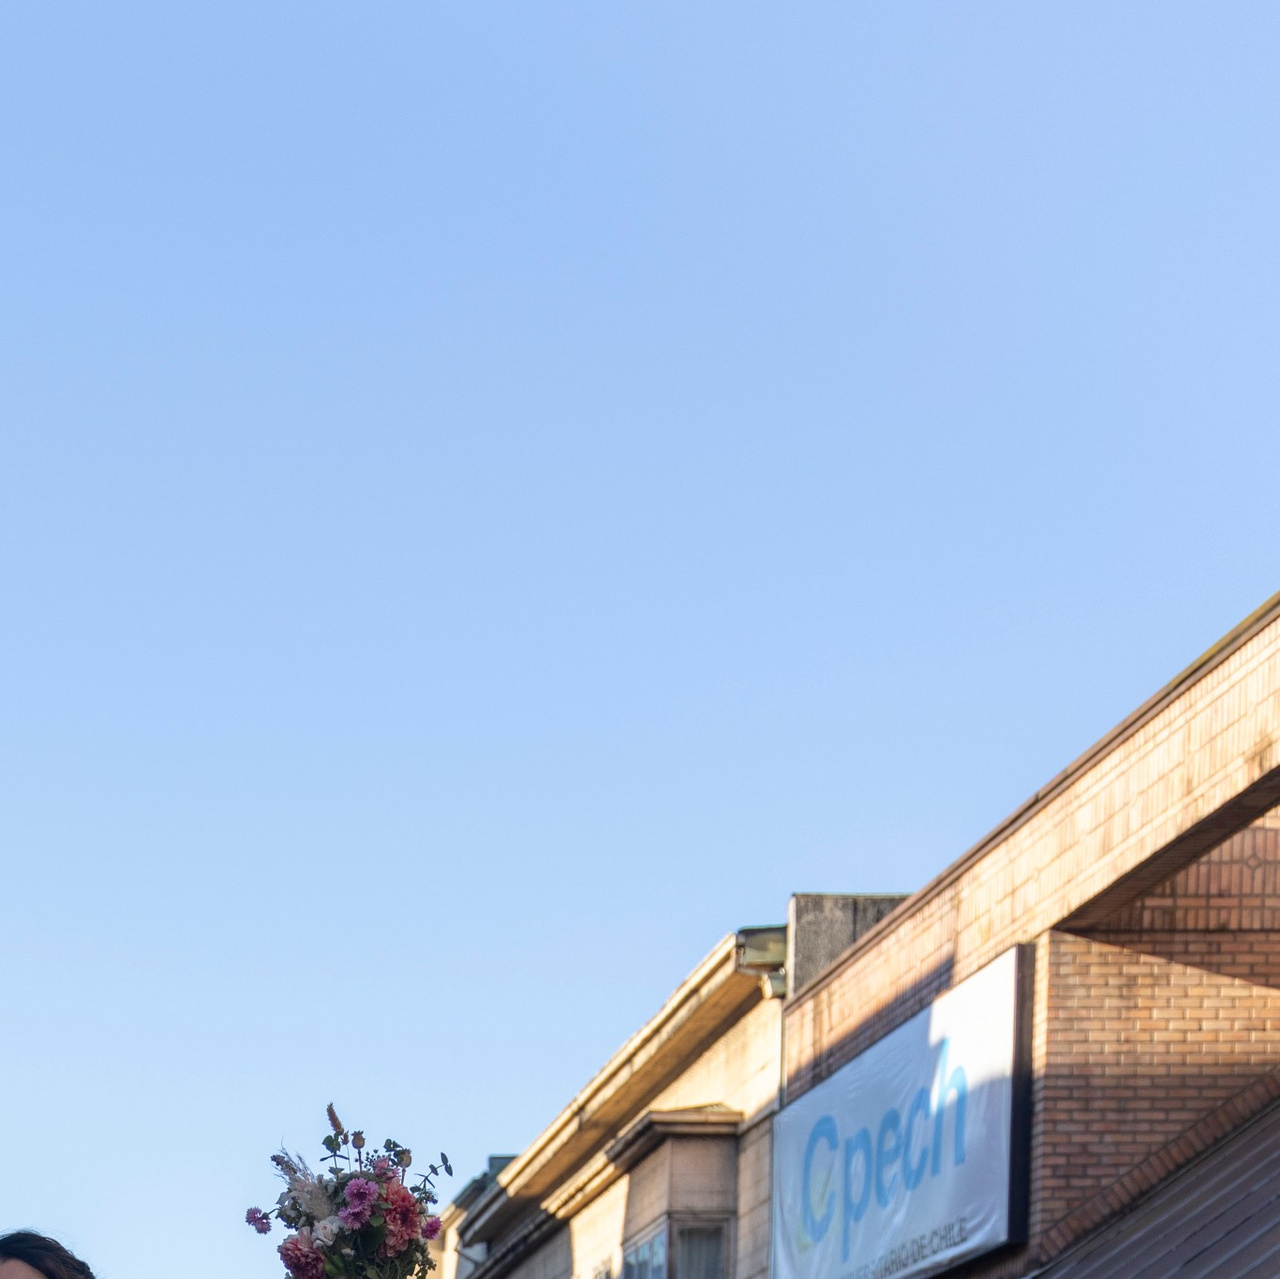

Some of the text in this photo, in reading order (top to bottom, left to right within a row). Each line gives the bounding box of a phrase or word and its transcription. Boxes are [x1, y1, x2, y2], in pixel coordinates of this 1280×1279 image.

[803, 1037, 967, 1264] Cpech
[913, 1234, 927, 1263] DE
[931, 1217, 968, 1255] CHILE
